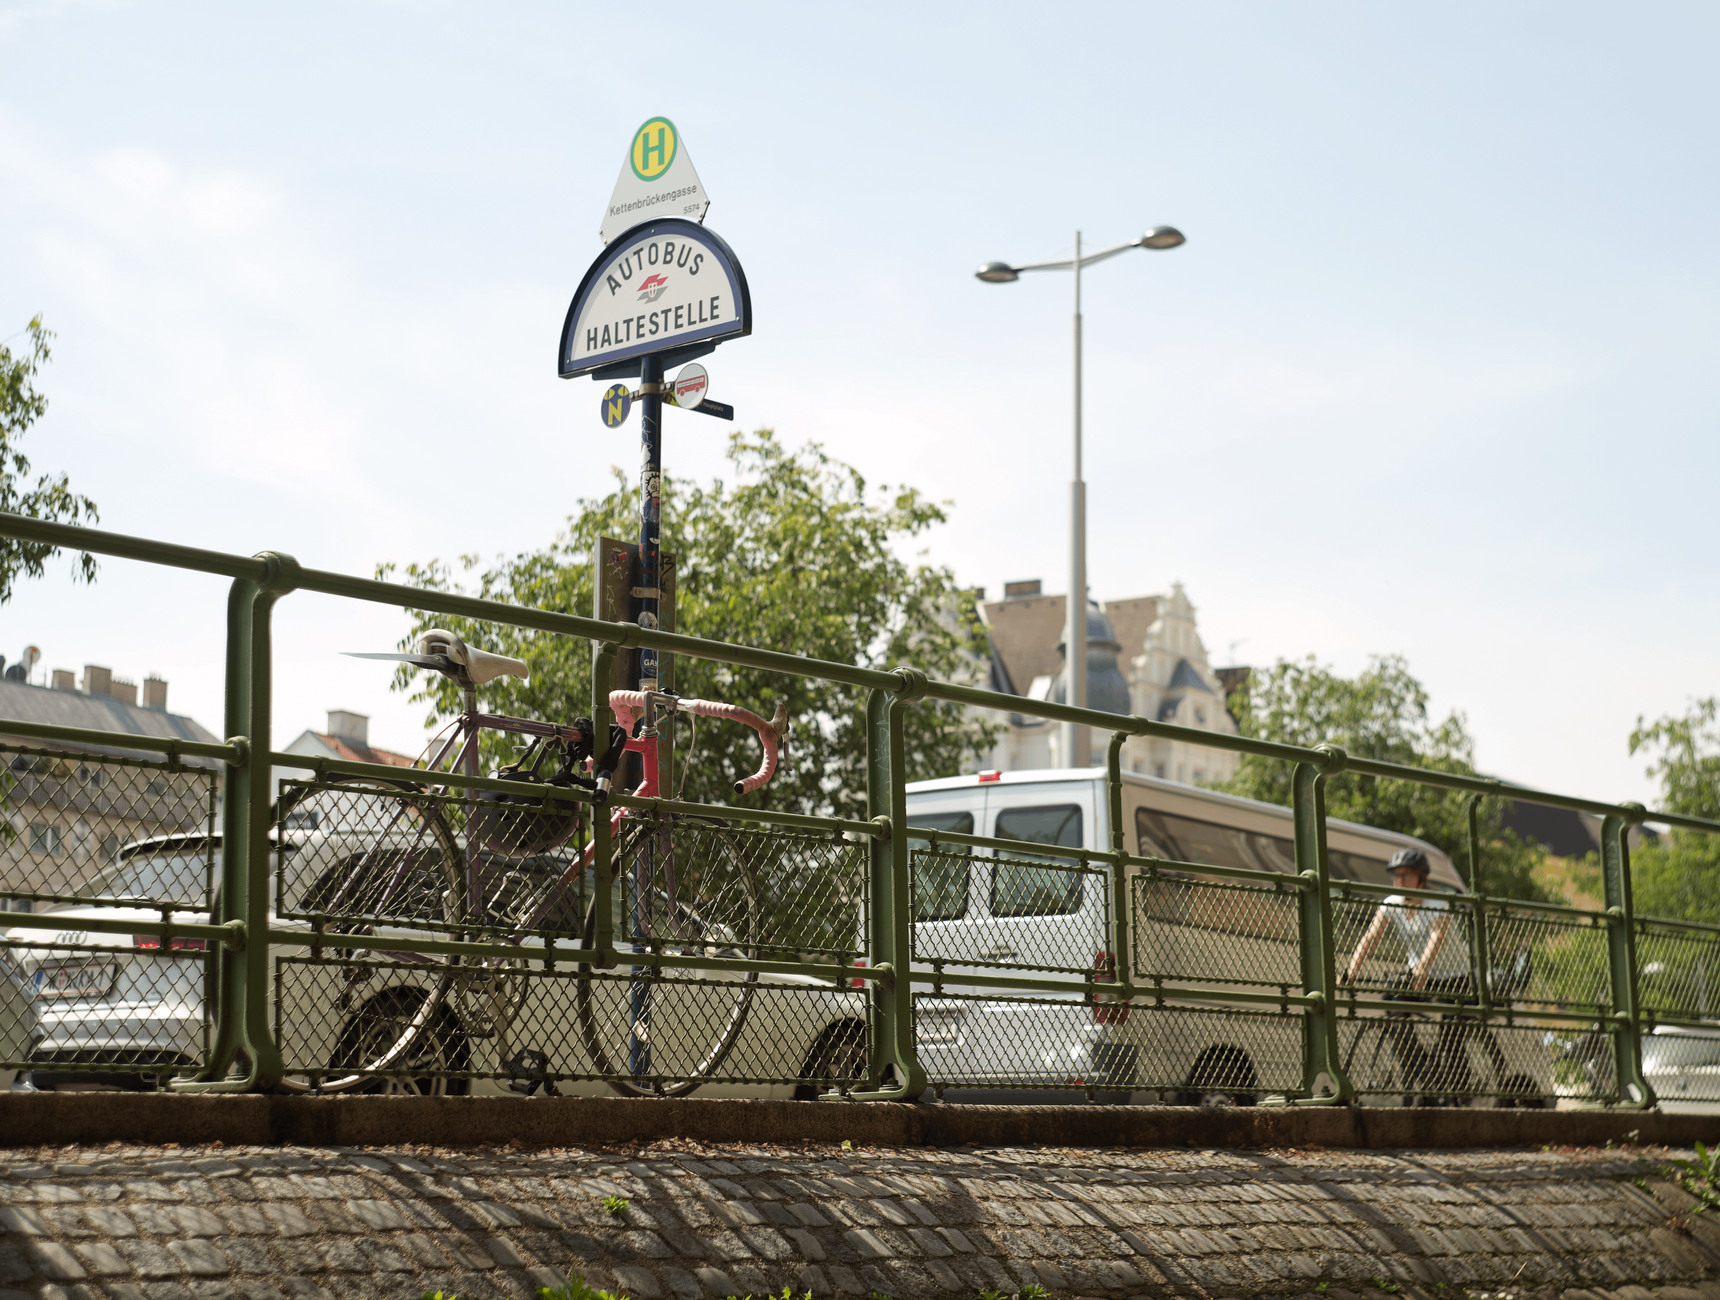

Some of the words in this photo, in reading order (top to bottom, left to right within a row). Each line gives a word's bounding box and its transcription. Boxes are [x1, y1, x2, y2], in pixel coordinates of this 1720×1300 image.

[642, 127, 665, 171] H
[610, 185, 698, 216] Kettenbrückengasse
[683, 203, 700, 215] 5574
[606, 242, 704, 296] AUTOBUS
[587, 295, 720, 352] HALTESTELLE
[607, 398, 623, 426] N
